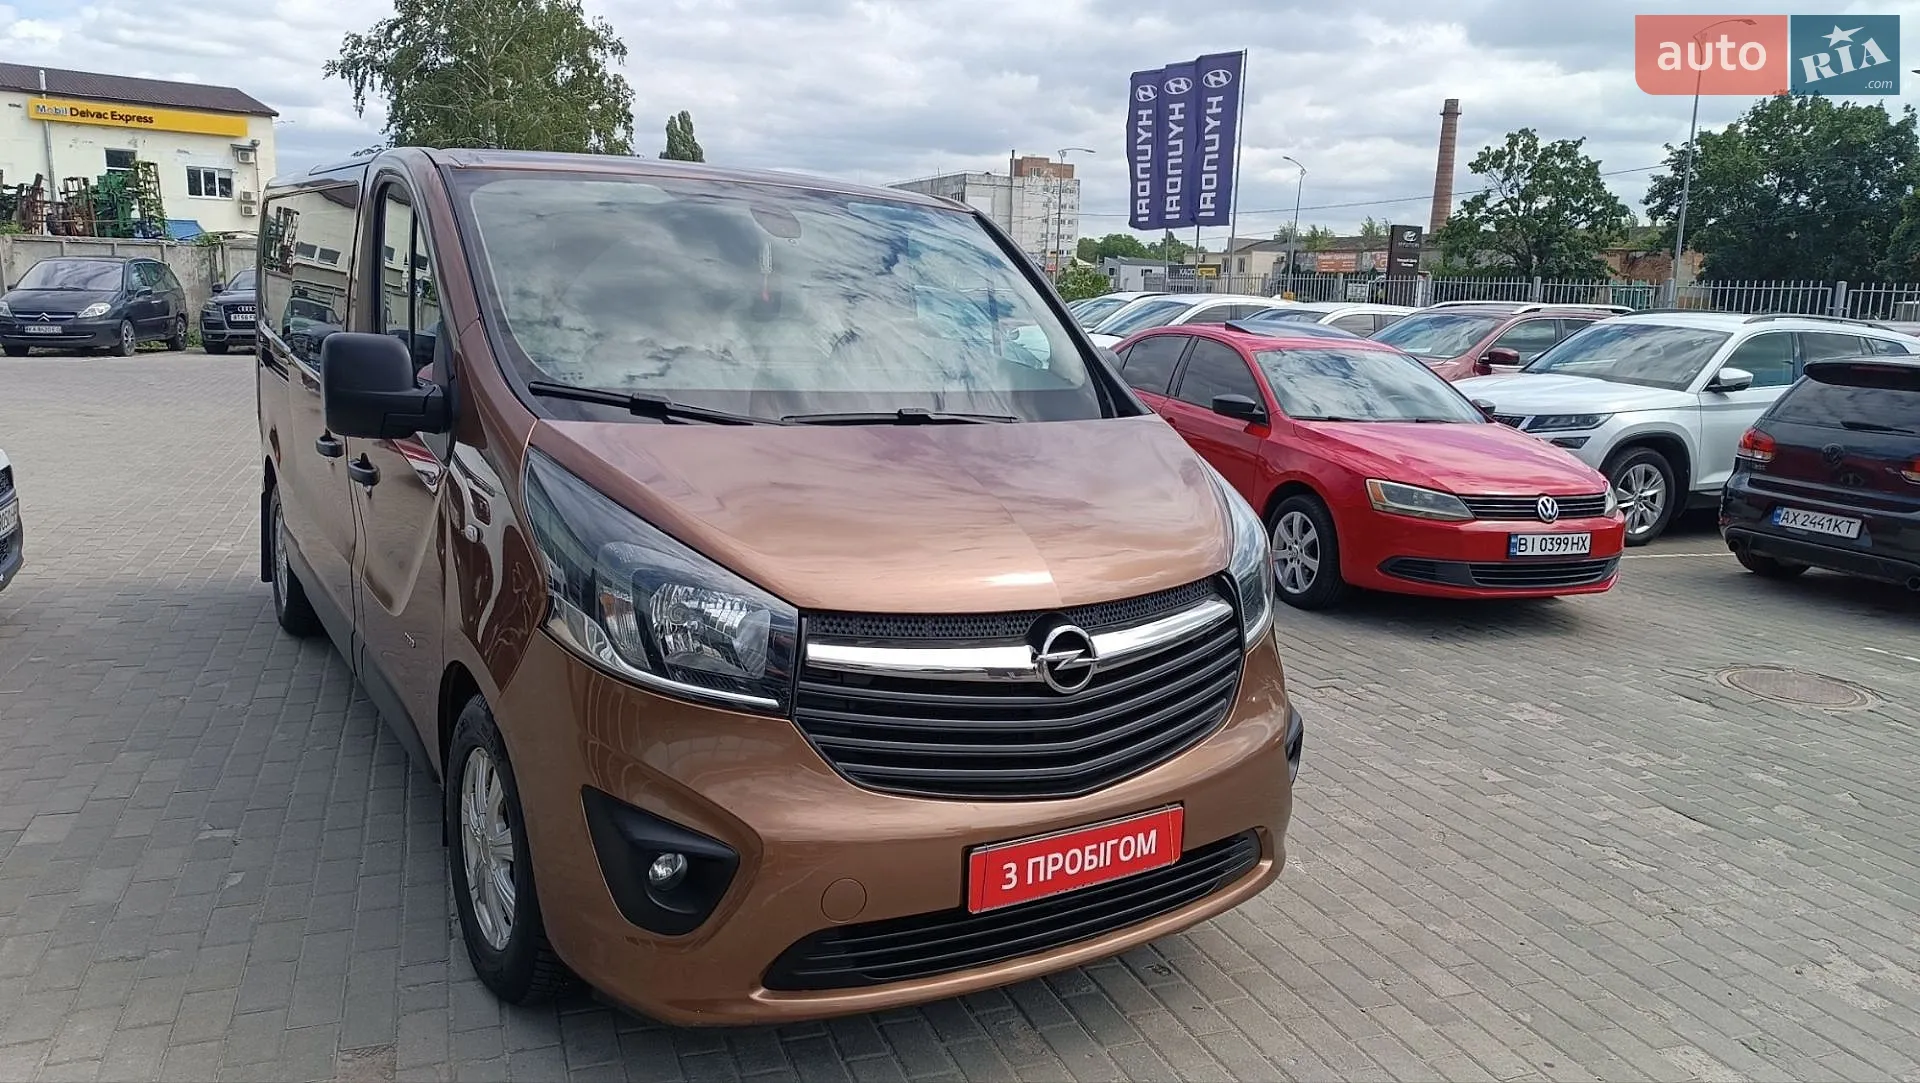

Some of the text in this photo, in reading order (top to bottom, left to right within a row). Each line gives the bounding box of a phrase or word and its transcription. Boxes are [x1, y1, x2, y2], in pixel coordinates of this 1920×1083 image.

[69, 107, 109, 120] Delvac
[110, 110, 154, 124] Express
[1026, 829, 1157, 885] ПРОБІГОМ
